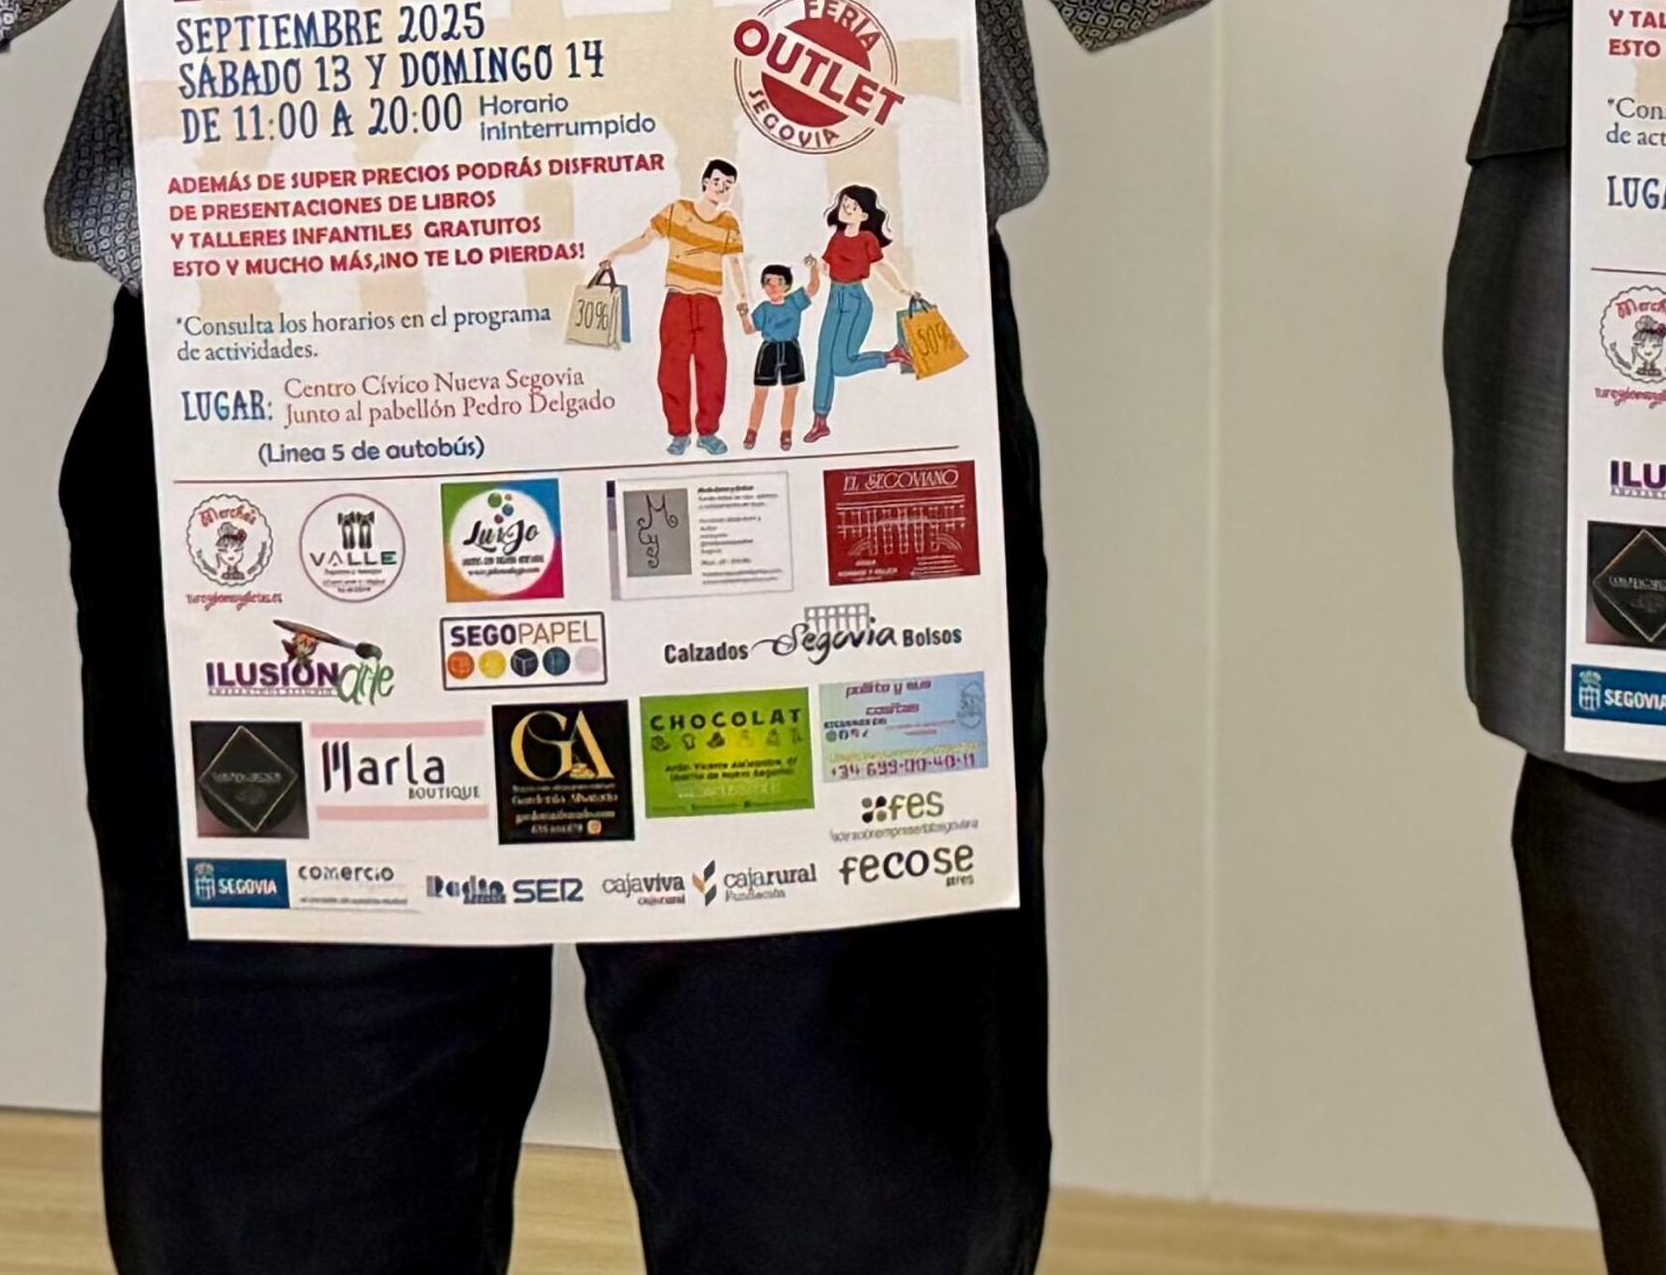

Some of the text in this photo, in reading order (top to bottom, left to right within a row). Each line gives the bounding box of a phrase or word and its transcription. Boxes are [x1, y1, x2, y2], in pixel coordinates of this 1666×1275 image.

[175, 0, 485, 55] SEPTIEMBRE 2025
[1608, 38, 1661, 58] ESTO
[177, 39, 604, 100] SÁBADO 13 Y DOMINGO 14
[180, 92, 462, 145] DE 11:00 A 20:00
[478, 92, 569, 117] Horario
[1605, 121, 1631, 144] de
[170, 215, 541, 250] Y TALLERES INFANTILES GRATUITOS
[172, 259, 221, 277] ESTO
[225, 259, 240, 276] Y
[245, 255, 324, 275] MUCHO
[423, 249, 449, 267] TE
[454, 247, 484, 266] LO
[489, 242, 584, 264] PIERDAS!
[283, 366, 585, 399] Centro Cívico Nueva Segovia
[180, 389, 273, 422] LUGAR:
[283, 387, 616, 430] Junto al pabellón Pedro Delgado
[331, 443, 345, 462] 5
[350, 439, 380, 461] de
[385, 434, 485, 460] autobús)
[309, 550, 397, 567] VALLE
[648, 705, 802, 733] CHOCOLAT
[838, 844, 974, 886] fecose
[216, 876, 278, 896] SEGOVIA
